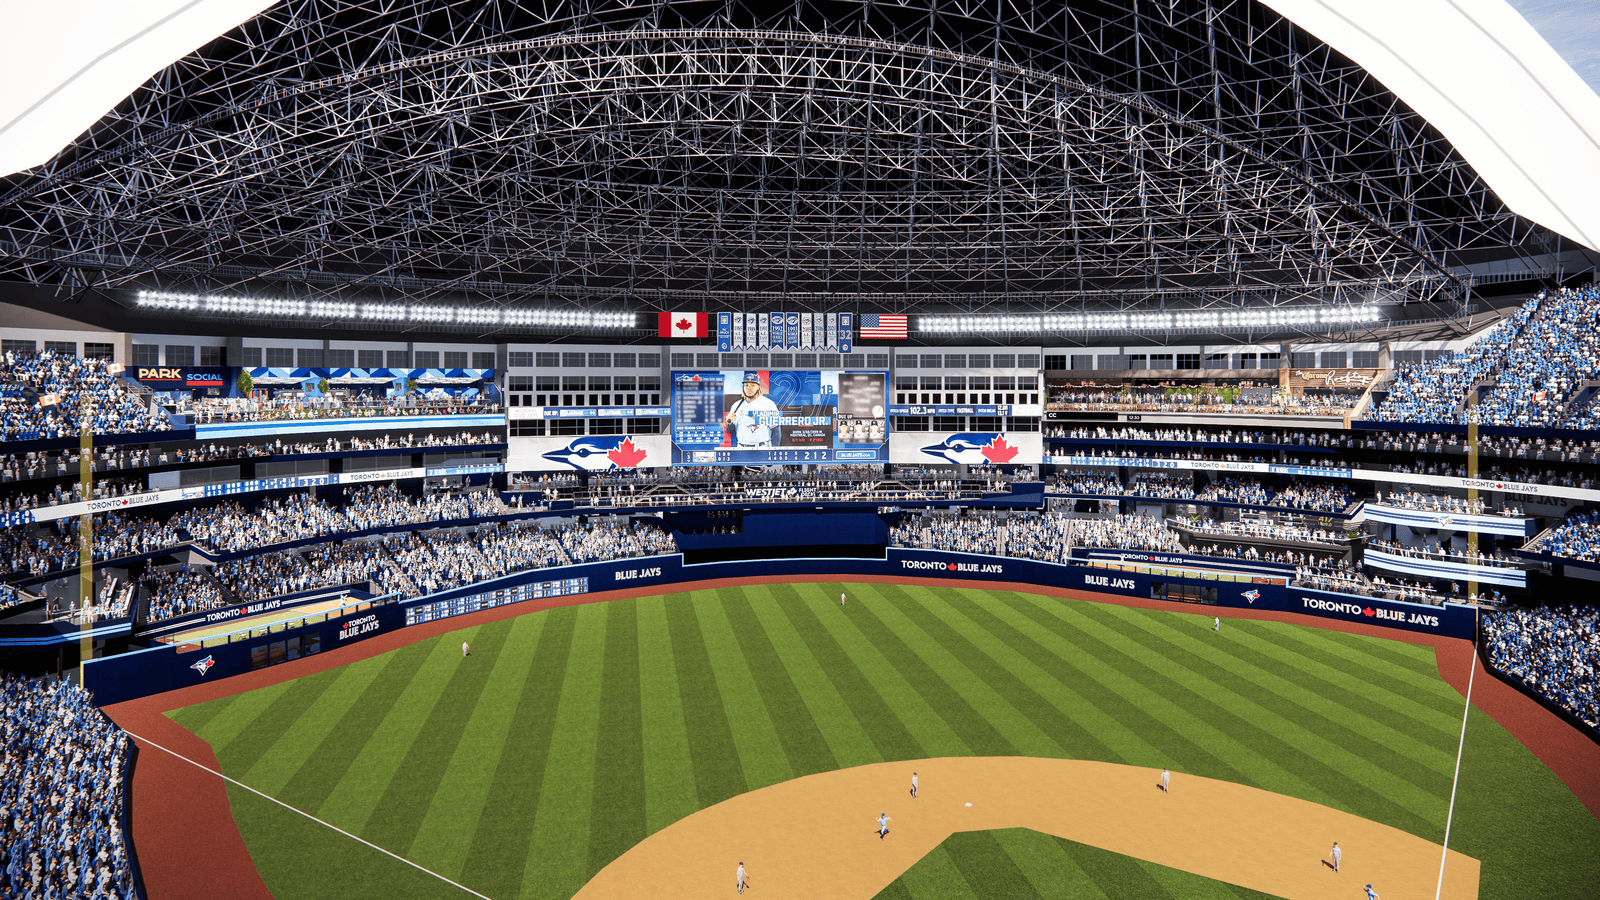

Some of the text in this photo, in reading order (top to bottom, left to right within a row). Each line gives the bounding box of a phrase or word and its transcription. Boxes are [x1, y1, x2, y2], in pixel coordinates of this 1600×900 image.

[839, 329, 852, 340] 32
[139, 368, 182, 379] PARK
[1325, 370, 1374, 386] Rooftop
[822, 385, 834, 394] 1B
[910, 406, 926, 414] 102.3
[759, 417, 829, 425] GUERRERO JR.
[1462, 480, 1495, 488] TORONTO
[746, 488, 787, 497] WESTJET
[87, 500, 122, 510] TORONTO
[145, 494, 159, 502] JAYS
[1505, 493, 1568, 507] BLUE JAYS
[901, 560, 1003, 573] TORONTO BLUE JAYS
[615, 567, 662, 581] BLUE JAYS
[1084, 574, 1136, 590] BLUE JAYS
[206, 600, 281, 622] TORONTO BLUE JAYS
[1302, 597, 1439, 627] TORONTO BLUE JAYS
[348, 614, 376, 628] TORONTO
[339, 619, 380, 640] BLUE JAYS
